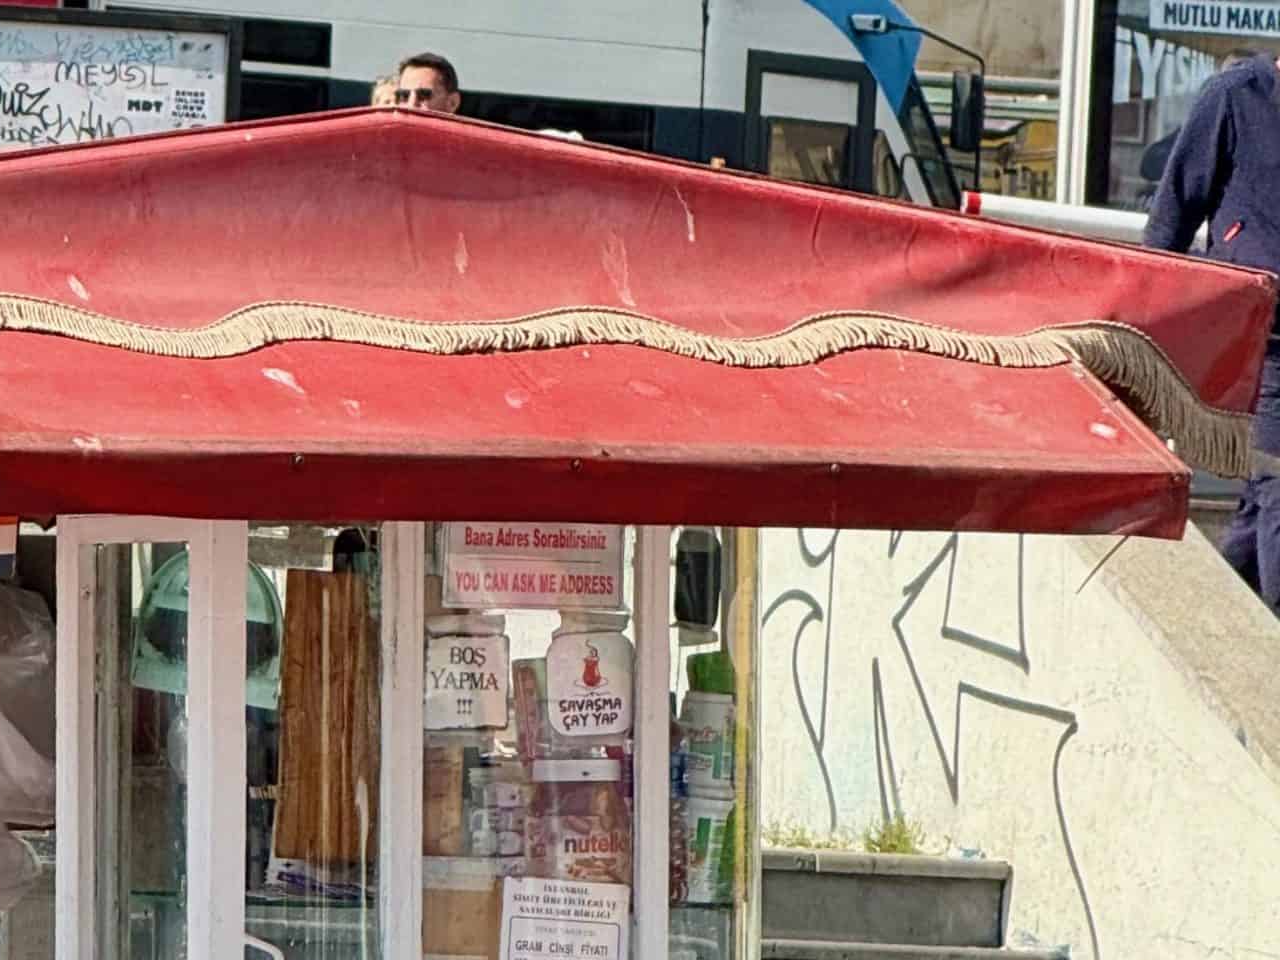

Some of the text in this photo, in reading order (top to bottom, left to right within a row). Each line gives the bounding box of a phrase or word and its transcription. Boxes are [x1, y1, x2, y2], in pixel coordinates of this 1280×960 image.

[1164, 3, 1280, 33] MUTLU MAKA
[127, 99, 163, 113] MDT
[464, 527, 608, 550] Bana Adres Sorabilirsiniz
[456, 571, 614, 595] YOU CAN ASK ME ADDRESS
[449, 646, 487, 667] BOŞ
[431, 669, 500, 691] YAPMA
[559, 697, 622, 714] SAVAŞMA
[562, 712, 619, 730] ÇAY YAP
[515, 940, 543, 952] GRAM
[580, 943, 609, 957] FİYATI
